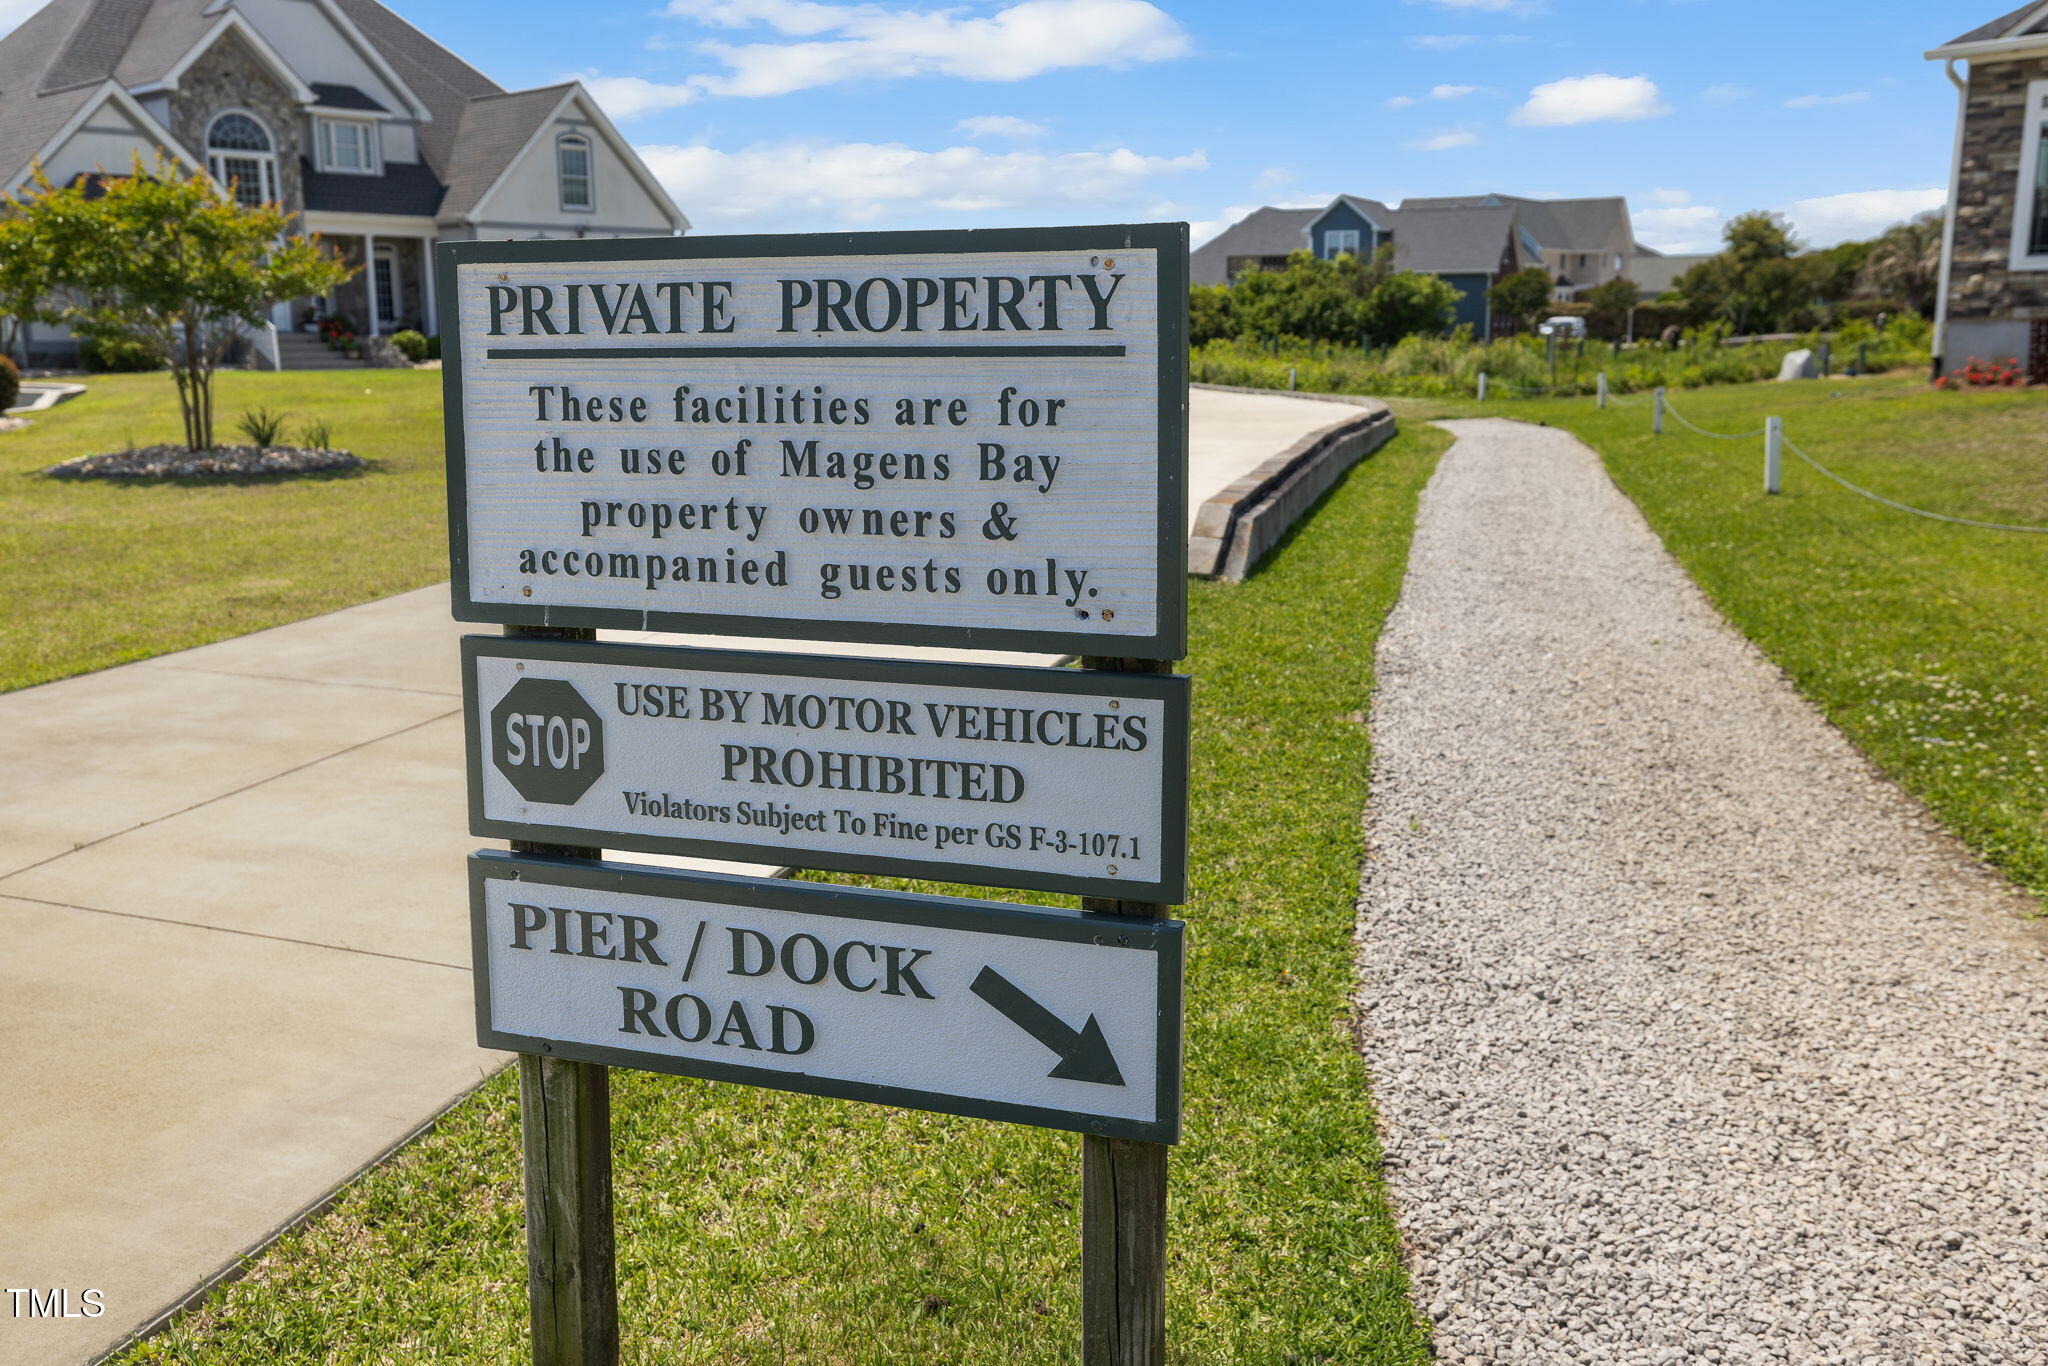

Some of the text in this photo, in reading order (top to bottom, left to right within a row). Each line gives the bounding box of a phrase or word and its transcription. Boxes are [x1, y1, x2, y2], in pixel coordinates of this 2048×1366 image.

[484, 273, 1126, 336] PRIVATE PROPERTY
[528, 385, 1066, 428] These facilities are for
[533, 436, 1061, 494] the use of Magens Bay
[579, 496, 1019, 542] property owners &
[519, 547, 1098, 608] accompanied guests only.
[505, 710, 592, 770] STOP
[613, 682, 1148, 753] USE BY MOTOR VEHICLES
[719, 743, 1026, 804] PROHIBITED
[621, 790, 1141, 861] Violators Subject To Fine per GS F-3-107.1
[507, 902, 936, 1001] PIER / DOCK
[616, 985, 815, 1056] ROAD
